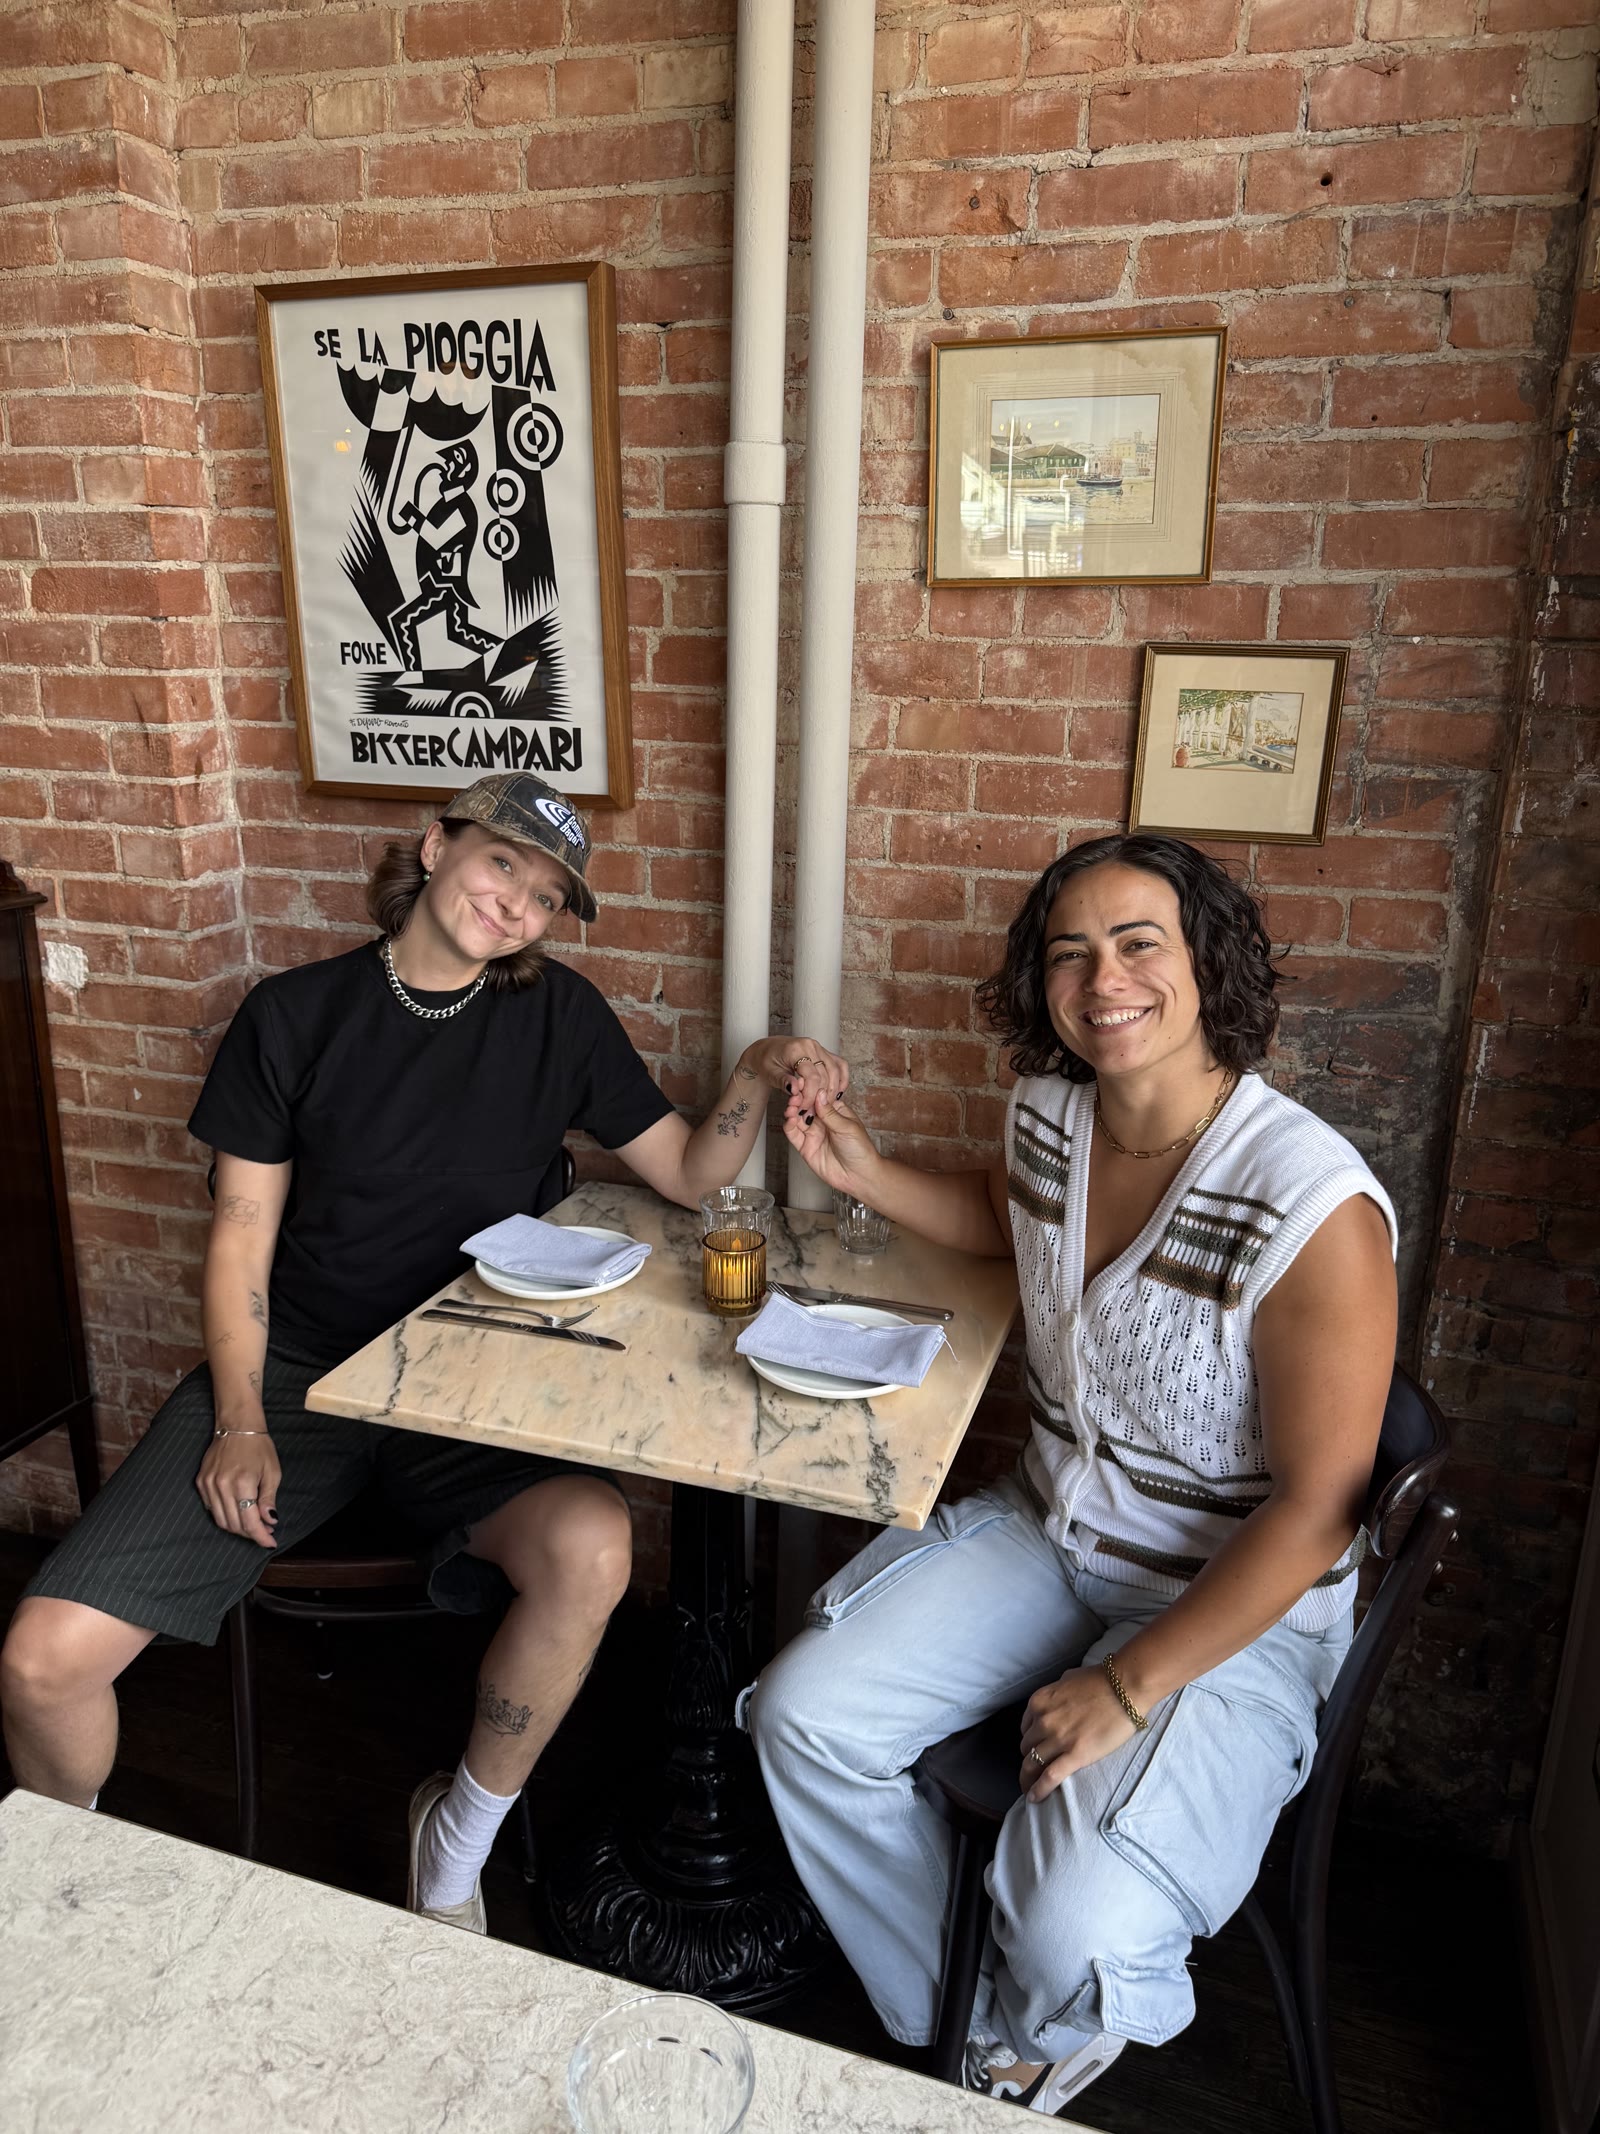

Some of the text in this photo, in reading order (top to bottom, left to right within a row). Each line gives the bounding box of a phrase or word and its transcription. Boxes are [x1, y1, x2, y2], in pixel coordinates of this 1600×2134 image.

[313, 318, 557, 394] SE LA PIOGGIA
[447, 726, 583, 772] CAMPARI
